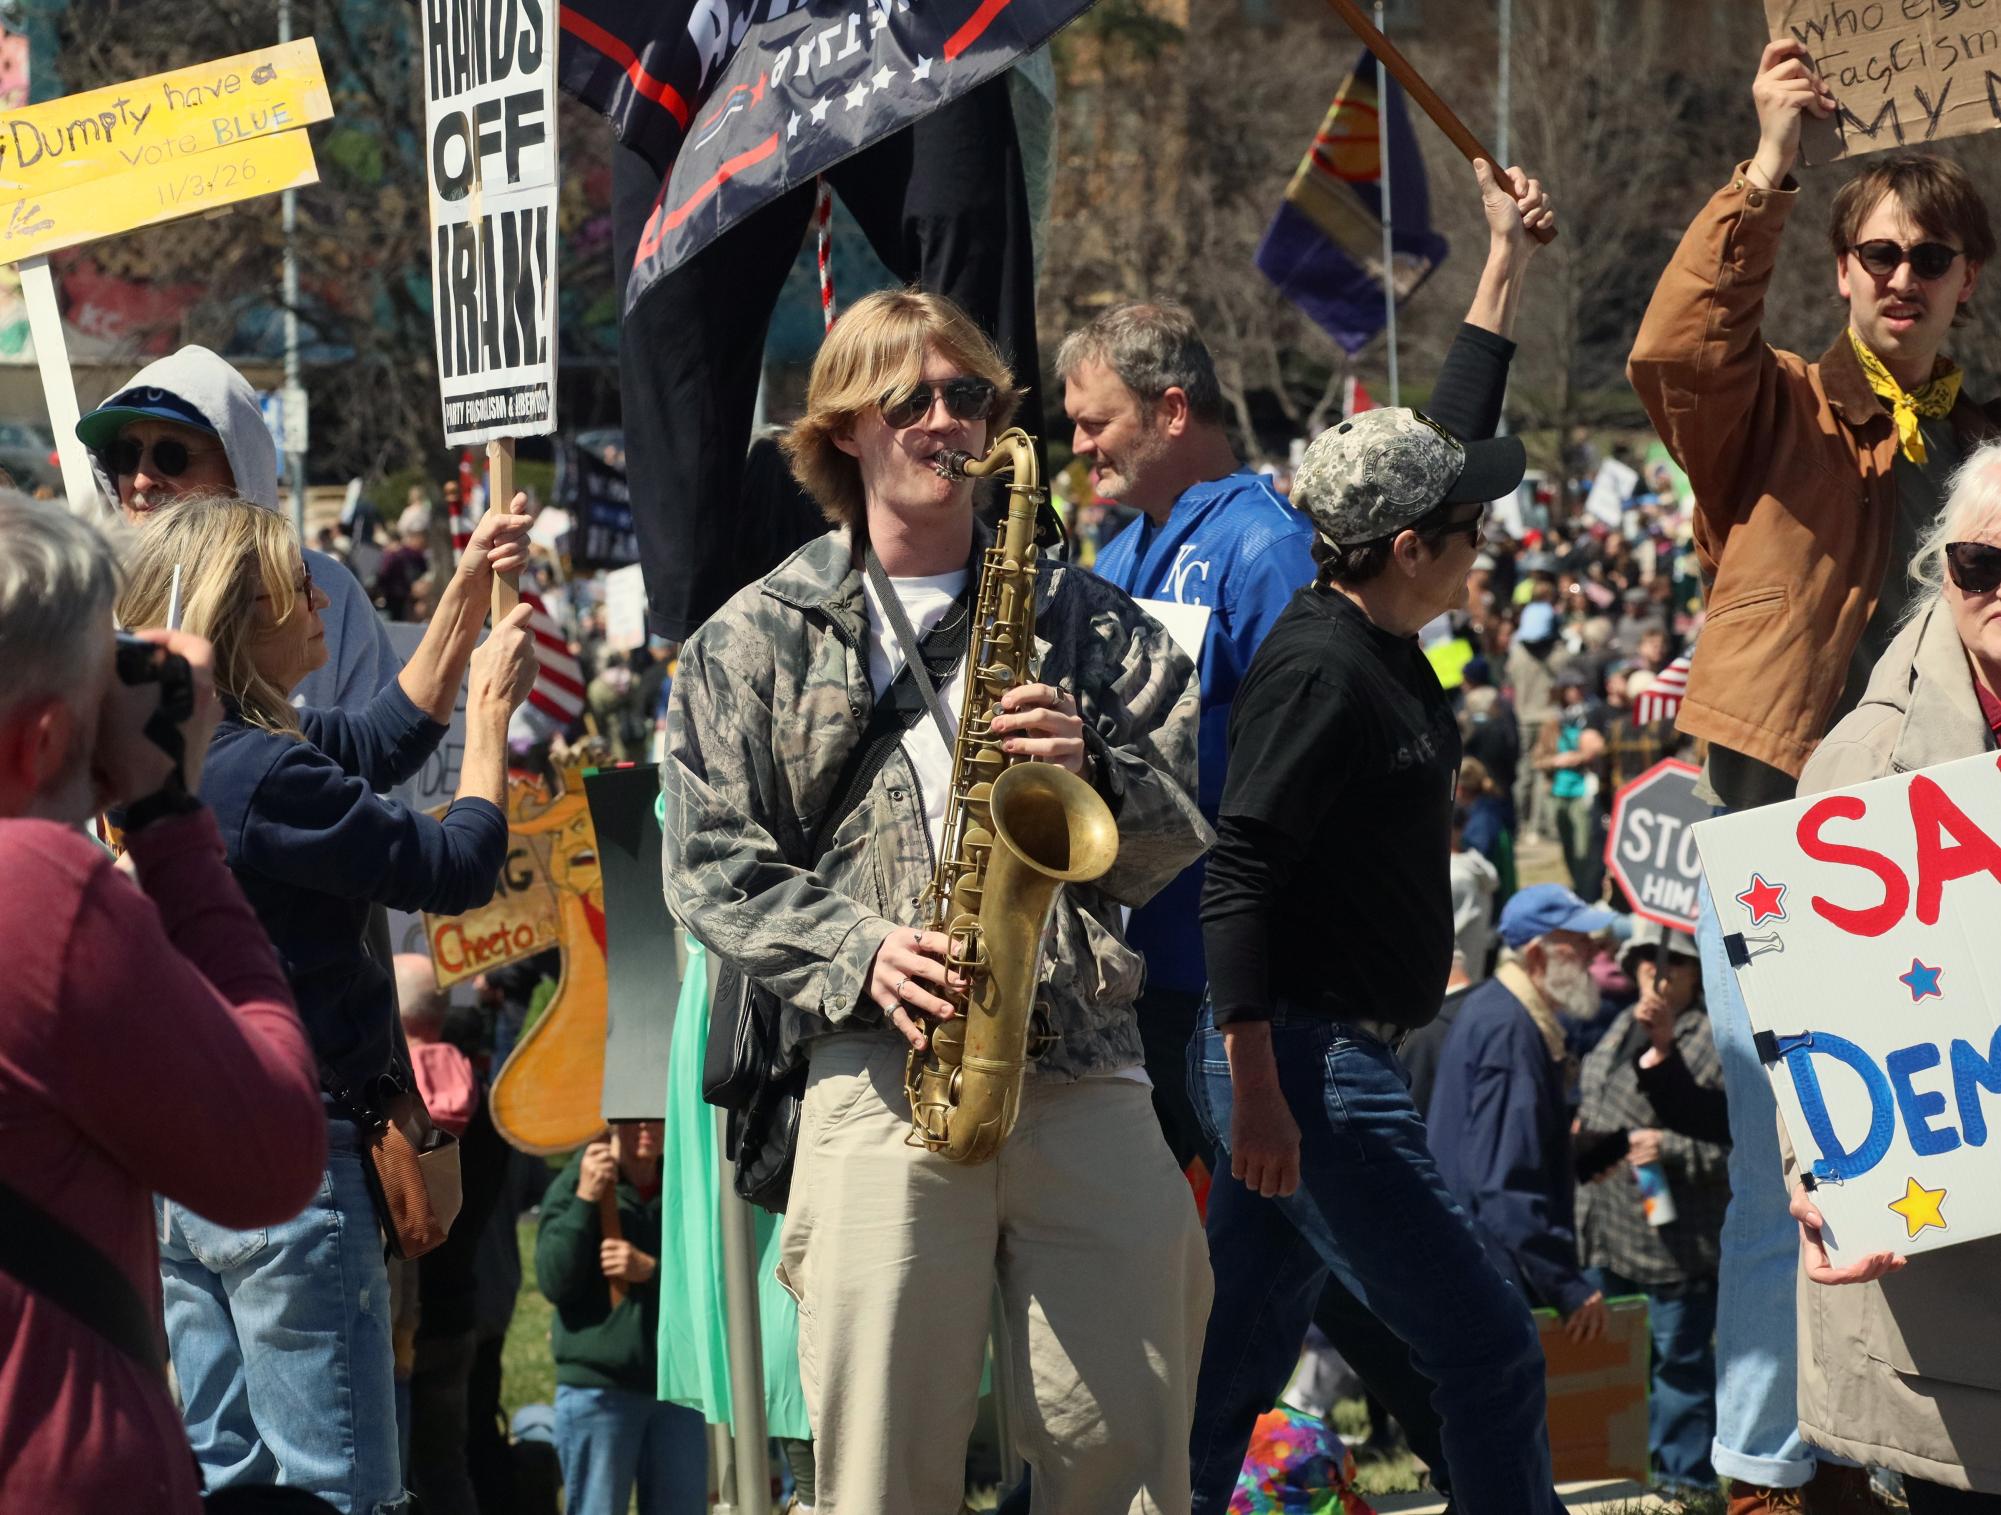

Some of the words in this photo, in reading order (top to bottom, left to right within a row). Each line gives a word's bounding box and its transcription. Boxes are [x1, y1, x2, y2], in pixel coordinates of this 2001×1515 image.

[427, 0, 544, 101] HANDS
[9, 97, 151, 168] Dumpty
[163, 74, 241, 110] have
[212, 102, 293, 145] BLUE
[433, 88, 545, 202] OFF
[1837, 76, 1953, 152] MY
[437, 205, 549, 378] IRAN!
[1162, 545, 1210, 606] KC
[1797, 755, 2001, 937] SA
